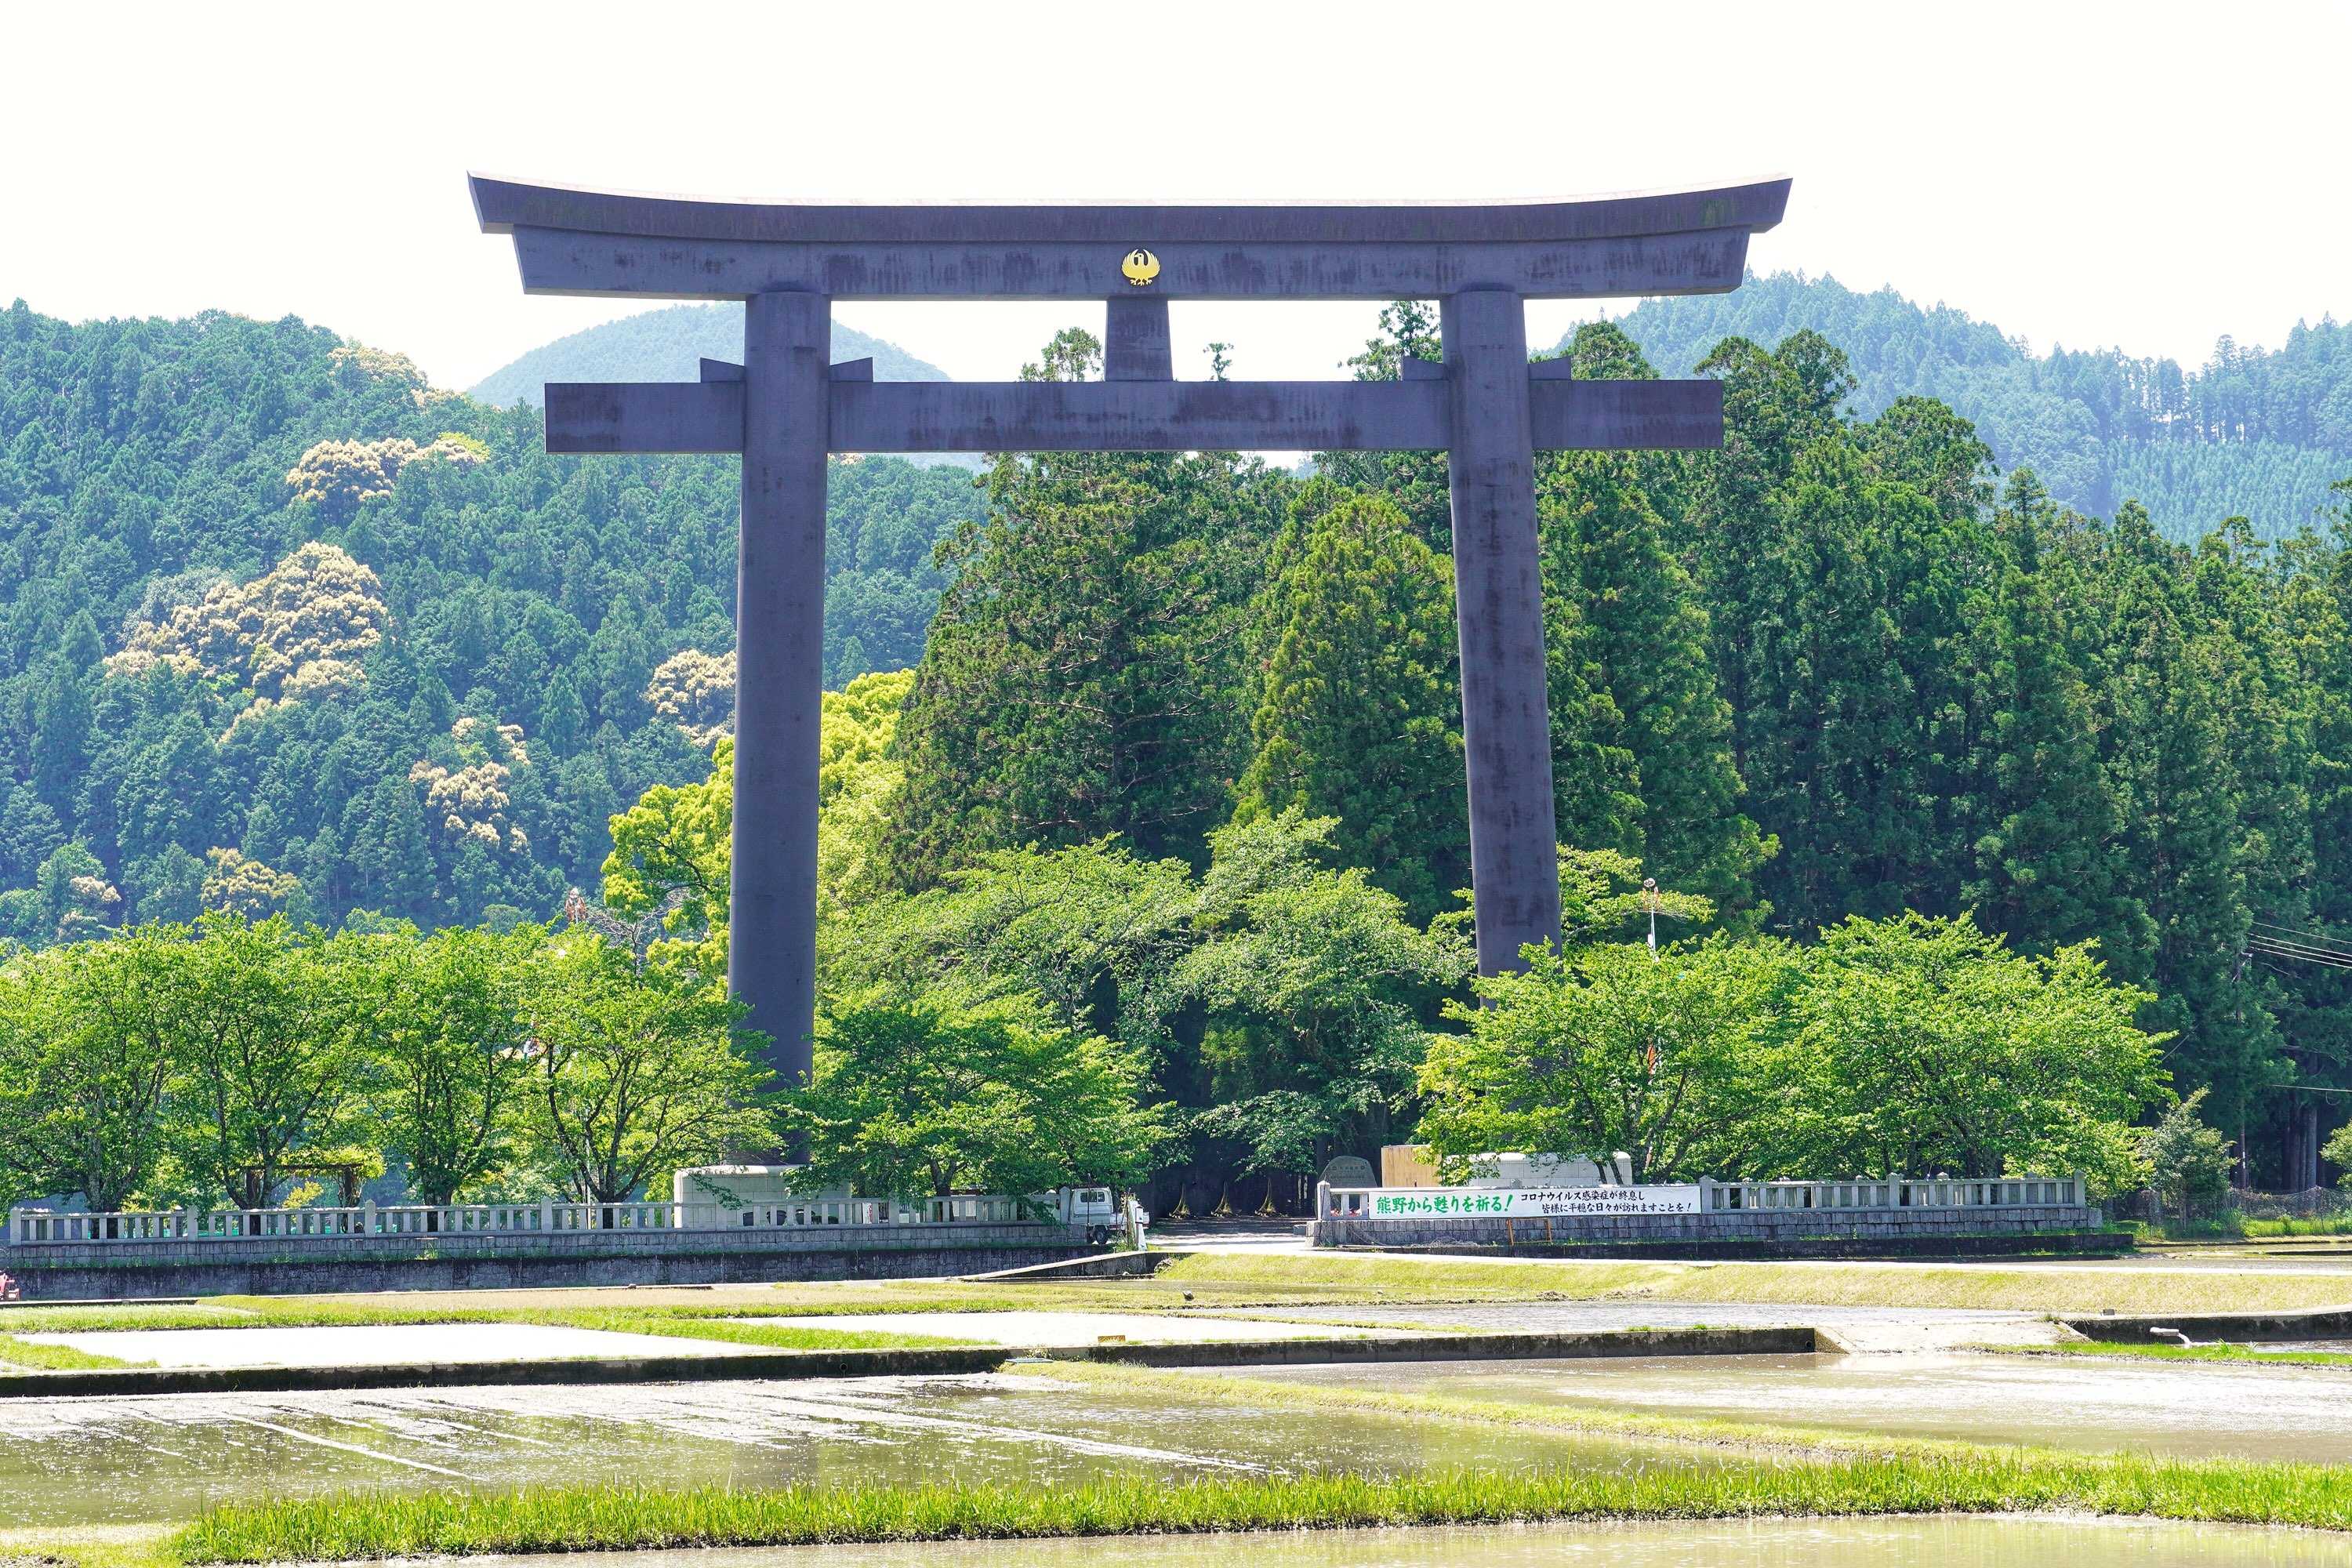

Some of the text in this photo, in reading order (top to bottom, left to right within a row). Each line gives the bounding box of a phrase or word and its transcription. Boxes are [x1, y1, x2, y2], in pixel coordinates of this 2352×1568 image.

[1520, 1189, 1645, 1202] コロナウイルス感染症が終息し
[1376, 1193, 1514, 1214] 熊野から甦りを祈る！
[1541, 1202, 1692, 1214] 皆様に平穏な日々が訪れますことを！
